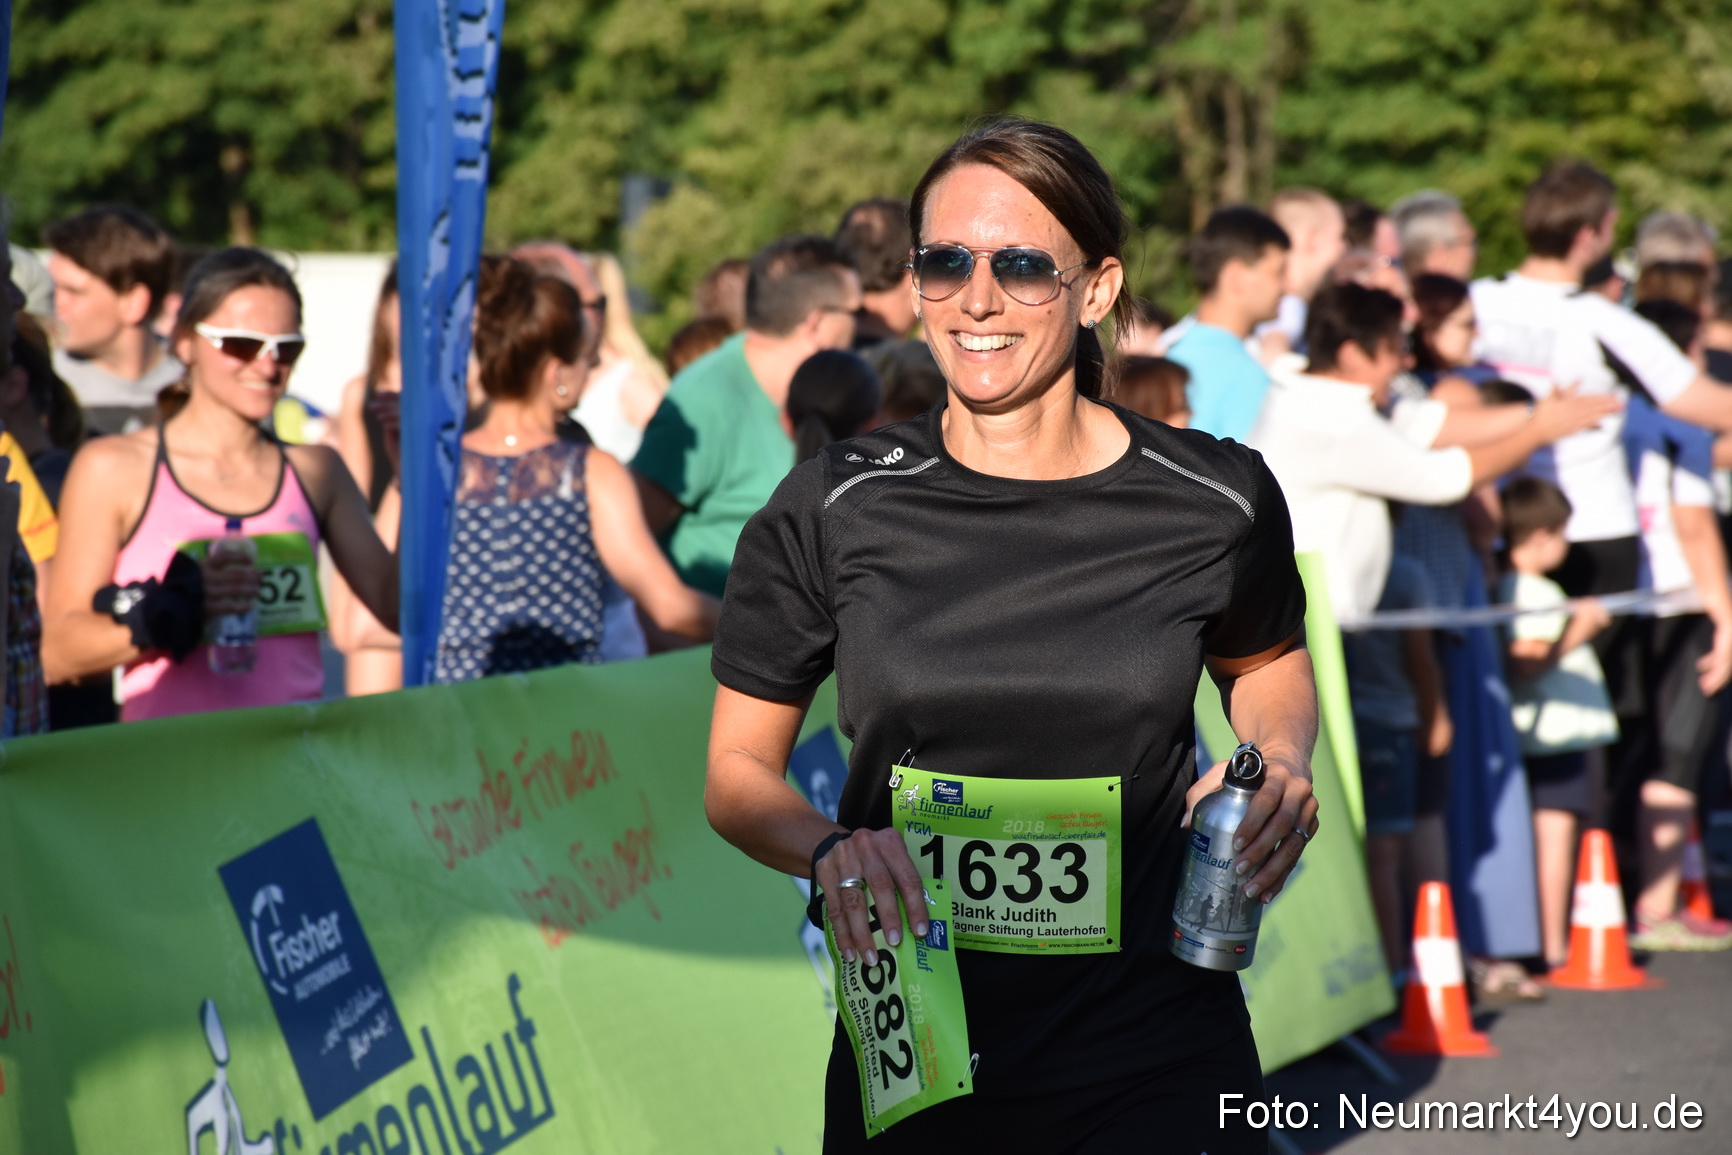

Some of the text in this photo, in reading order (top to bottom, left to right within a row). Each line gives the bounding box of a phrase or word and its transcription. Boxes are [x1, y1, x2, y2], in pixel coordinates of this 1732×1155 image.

[868, 447, 904, 466] AKO
[919, 797, 994, 819] firmenlauf
[920, 812, 950, 821] neumarkt
[1002, 819, 1045, 834] 2018
[920, 834, 1089, 904] 1633
[952, 901, 1057, 923] Blank Judith
[952, 919, 1107, 938] agner Stiftung Lauterhofen
[268, 911, 343, 979] Fischer
[908, 984, 925, 1025] 2018
[858, 997, 880, 1078] Siegfried
[848, 1000, 866, 1046] Stiftung
[863, 1047, 877, 1118] Lauterhofen
